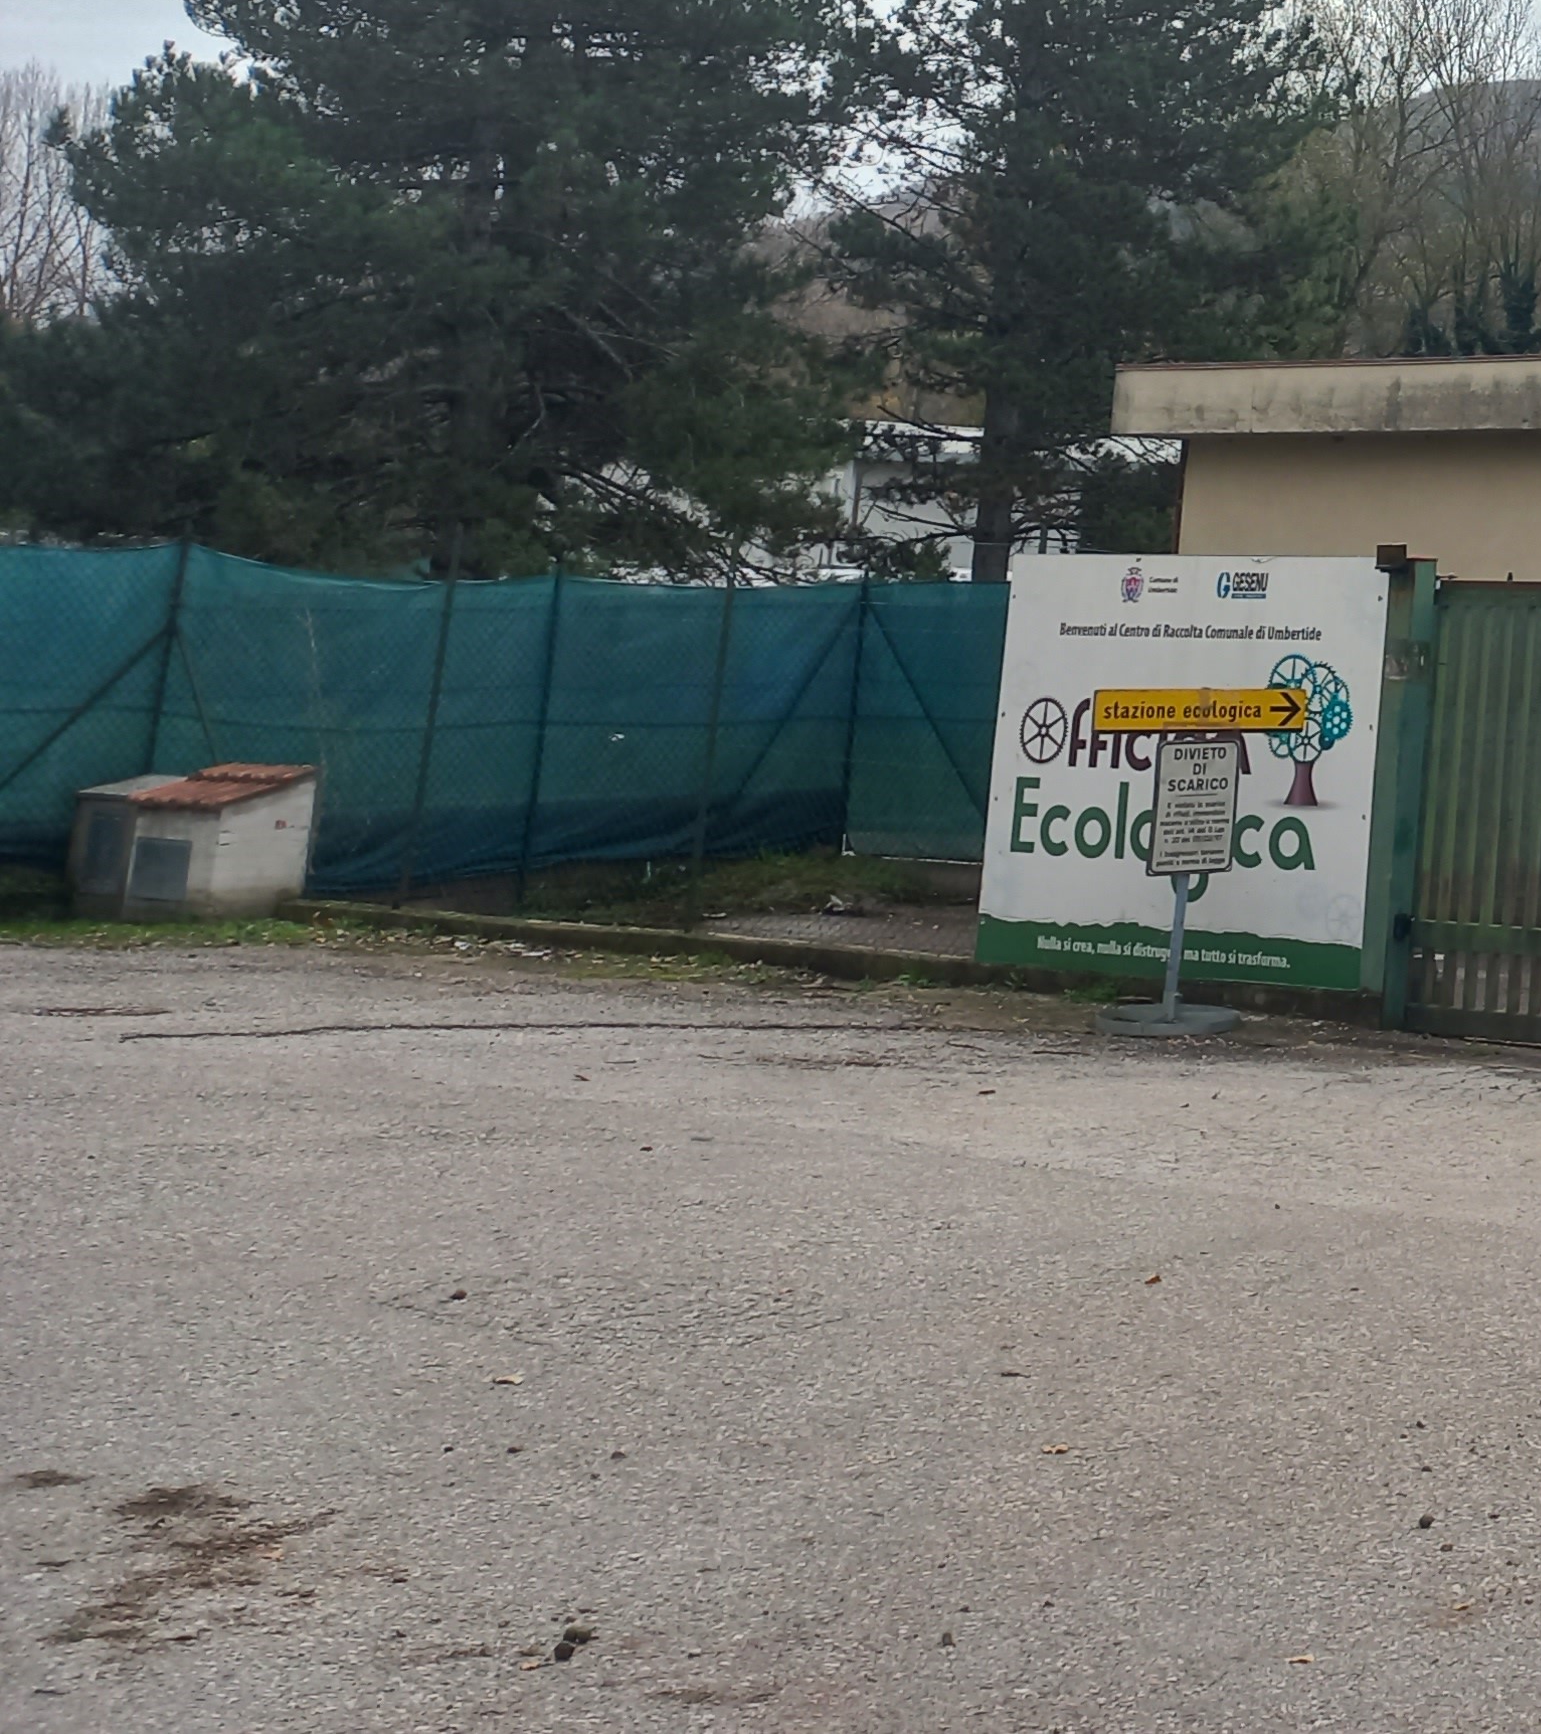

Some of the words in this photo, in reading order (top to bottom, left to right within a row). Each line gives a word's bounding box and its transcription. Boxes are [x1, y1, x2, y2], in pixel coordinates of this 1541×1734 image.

[1232, 572, 1269, 592] GESENU
[1059, 622, 1107, 636] Benvenuti
[1108, 623, 1118, 636] al
[1119, 623, 1150, 637] Centro
[1152, 624, 1161, 637] di
[1163, 624, 1203, 638] Raccolta
[1204, 624, 1254, 639] Comunale
[1255, 625, 1266, 639] di
[1267, 626, 1322, 640] Umbertide
[1103, 701, 1176, 719] stazione
[1183, 700, 1262, 723] ecologica
[1174, 747, 1227, 760] DIVIETO
[1193, 763, 1206, 775] DI
[1167, 777, 1229, 792] SCARICO
[1037, 935, 1062, 950] Nulla
[1063, 937, 1072, 951] si
[1072, 941, 1095, 955] crea,
[1097, 940, 1121, 955] nulla
[1122, 941, 1131, 956] si
[1183, 949, 1200, 961] ma
[1201, 948, 1227, 964] tutto
[1227, 949, 1237, 964] si
[1237, 951, 1291, 968] trasforma.
